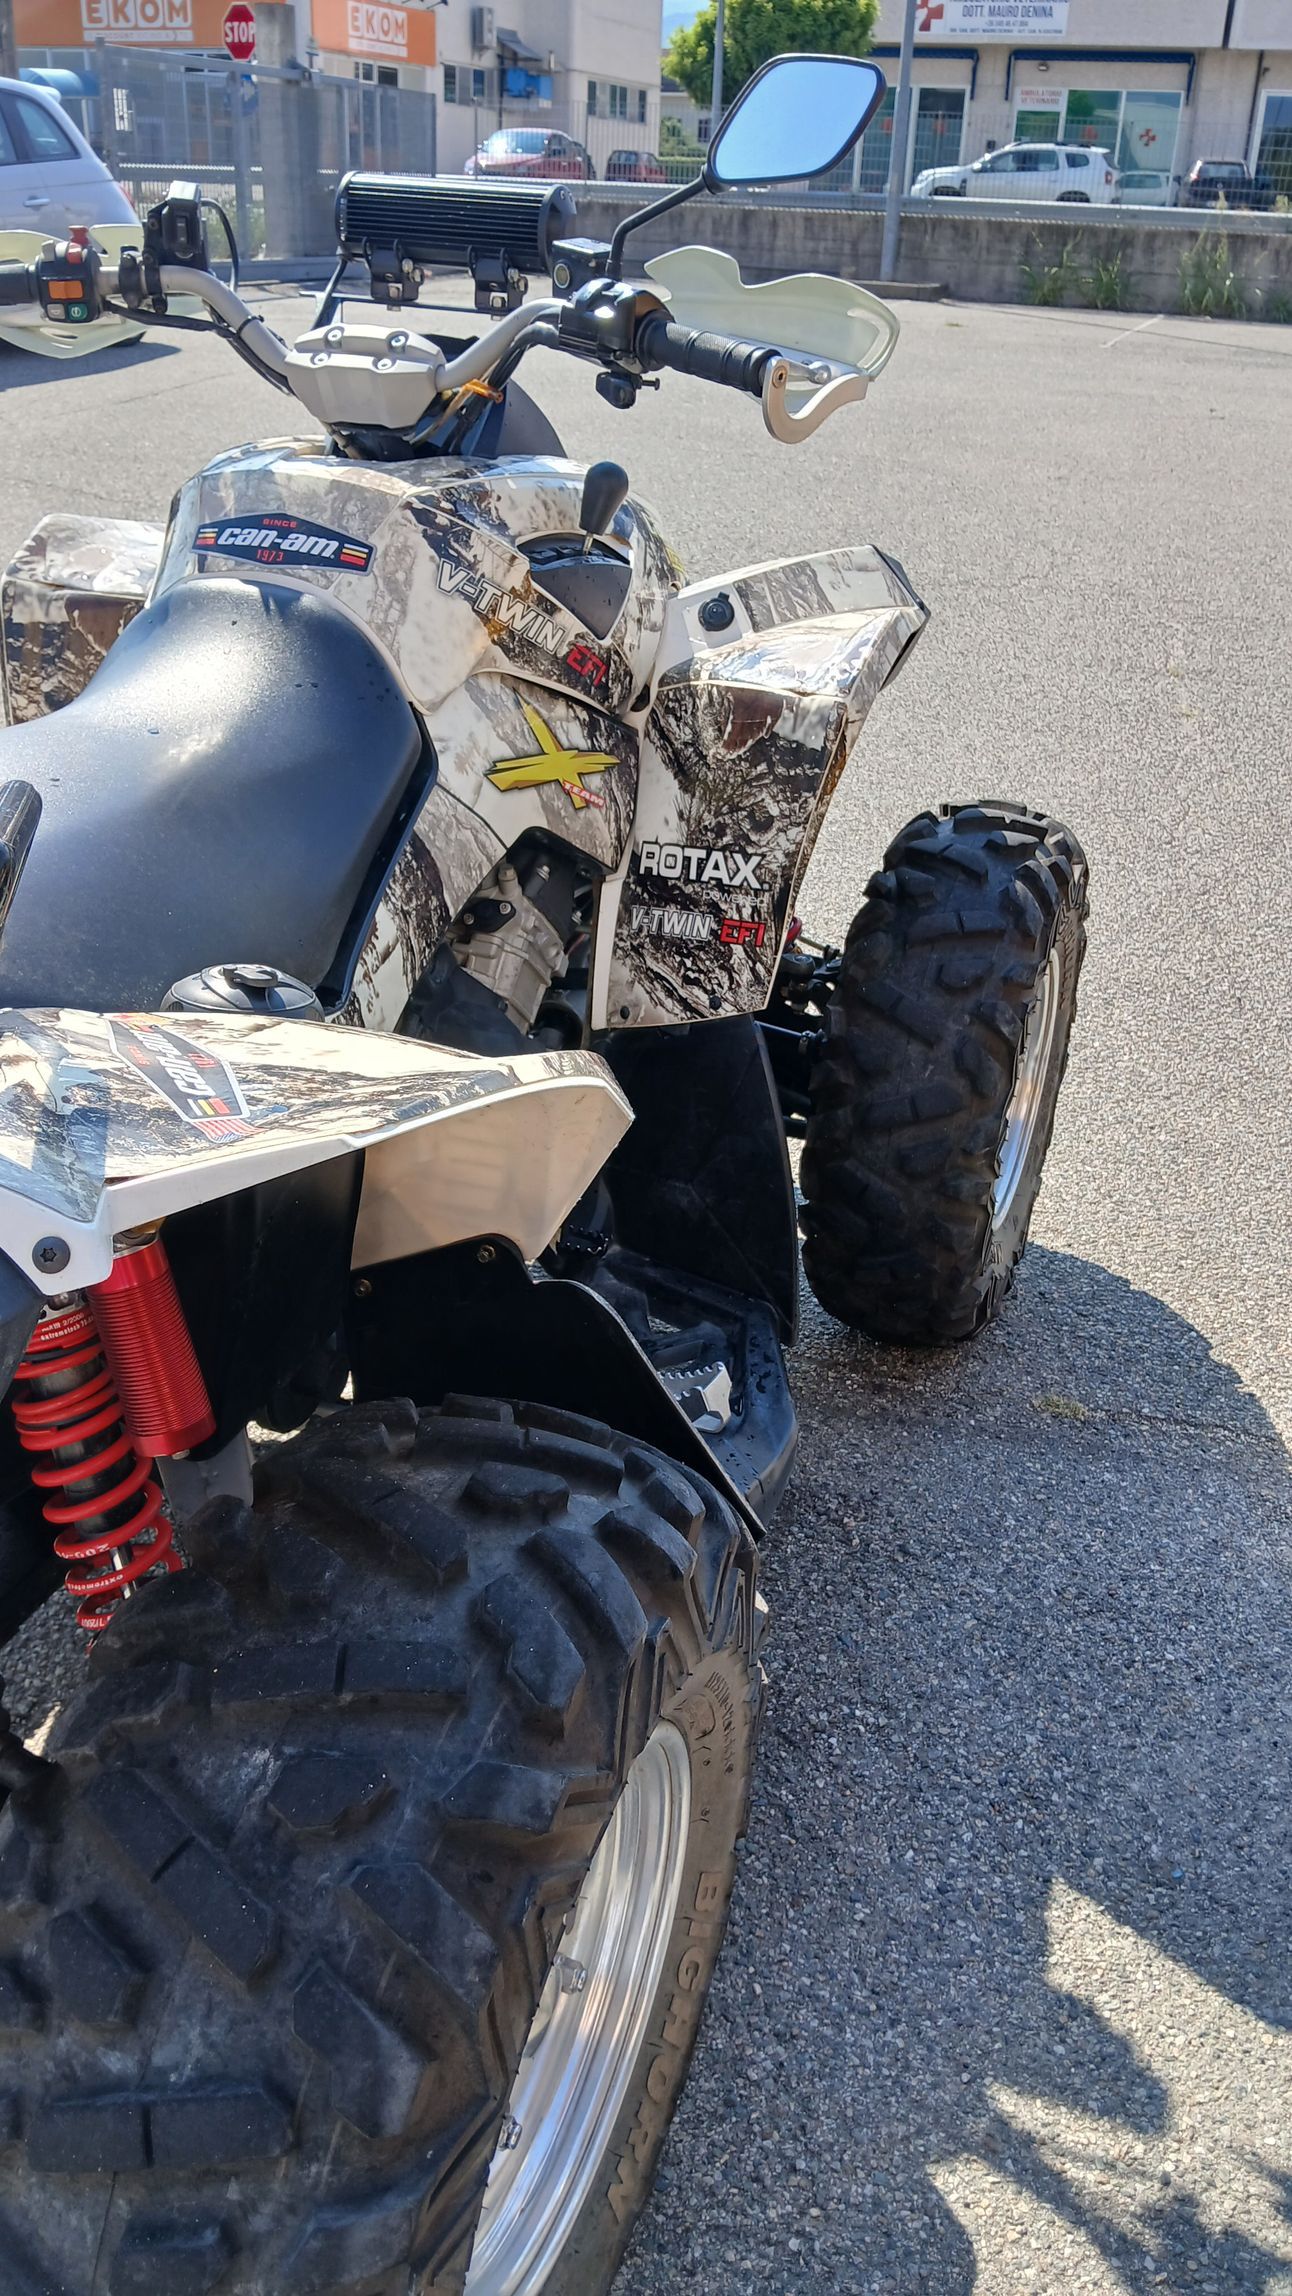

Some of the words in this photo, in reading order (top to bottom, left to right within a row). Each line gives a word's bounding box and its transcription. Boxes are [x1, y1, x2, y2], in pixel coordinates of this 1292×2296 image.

[85, 0, 189, 24] EKOM
[351, 6, 405, 40] EKOM
[988, 4, 1020, 18] MAURO
[1020, 5, 1054, 18] DENINA
[224, 21, 257, 43] STOP
[262, 518, 298, 529] SINCE
[217, 527, 339, 558] can-am
[256, 549, 285, 562] 1973
[437, 558, 567, 655] V-TWIN
[566, 643, 608, 687] EFI
[562, 780, 606, 808] TEAM
[639, 842, 764, 890] ROTAX
[630, 905, 714, 941] V-TWIN
[719, 919, 767, 948] EFI
[606, 1871, 724, 2225] BIGHORN
